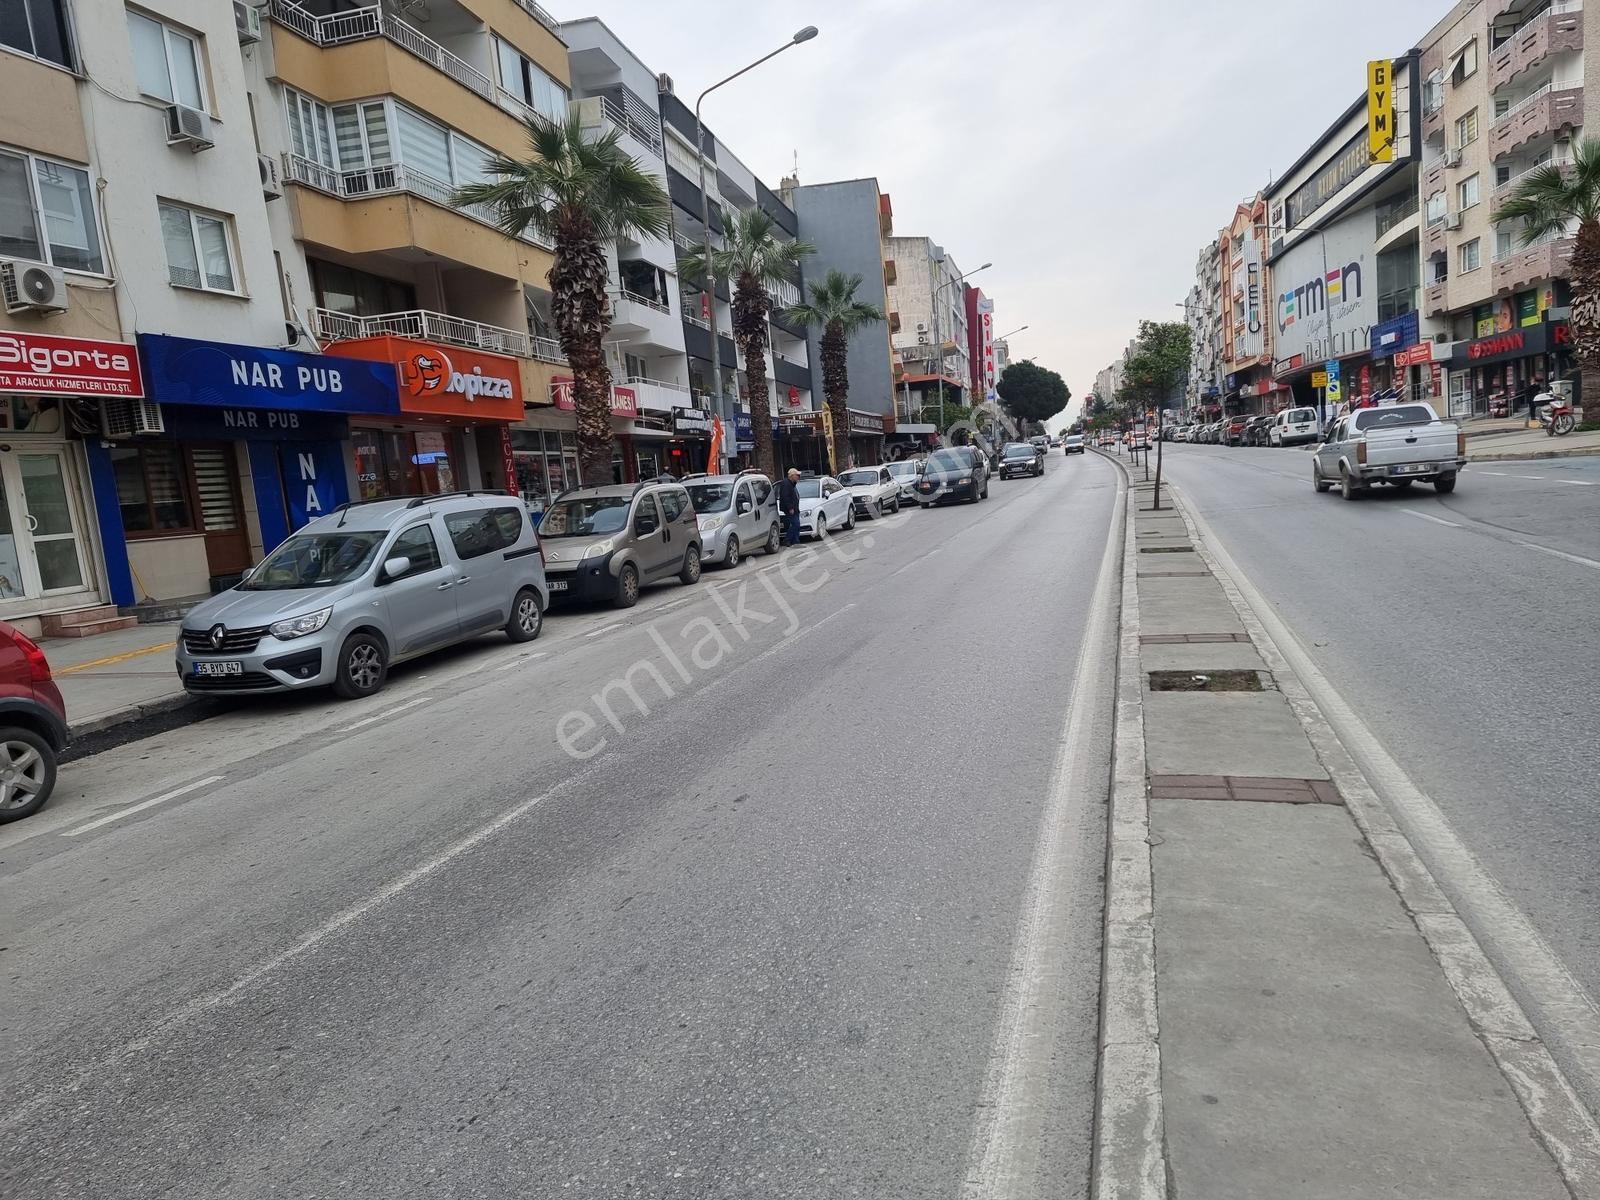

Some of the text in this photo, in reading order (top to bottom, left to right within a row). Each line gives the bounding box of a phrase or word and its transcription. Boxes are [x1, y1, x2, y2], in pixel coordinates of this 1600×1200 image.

[1375, 68, 1386, 132] GYM
[0, 336, 130, 373] Sigorta
[15, 377, 55, 388] ARACILIK
[231, 359, 342, 393] NAR PUB
[223, 410, 300, 428] NAR PUB
[198, 663, 208, 673] 35
[226, 661, 240, 673] 647
